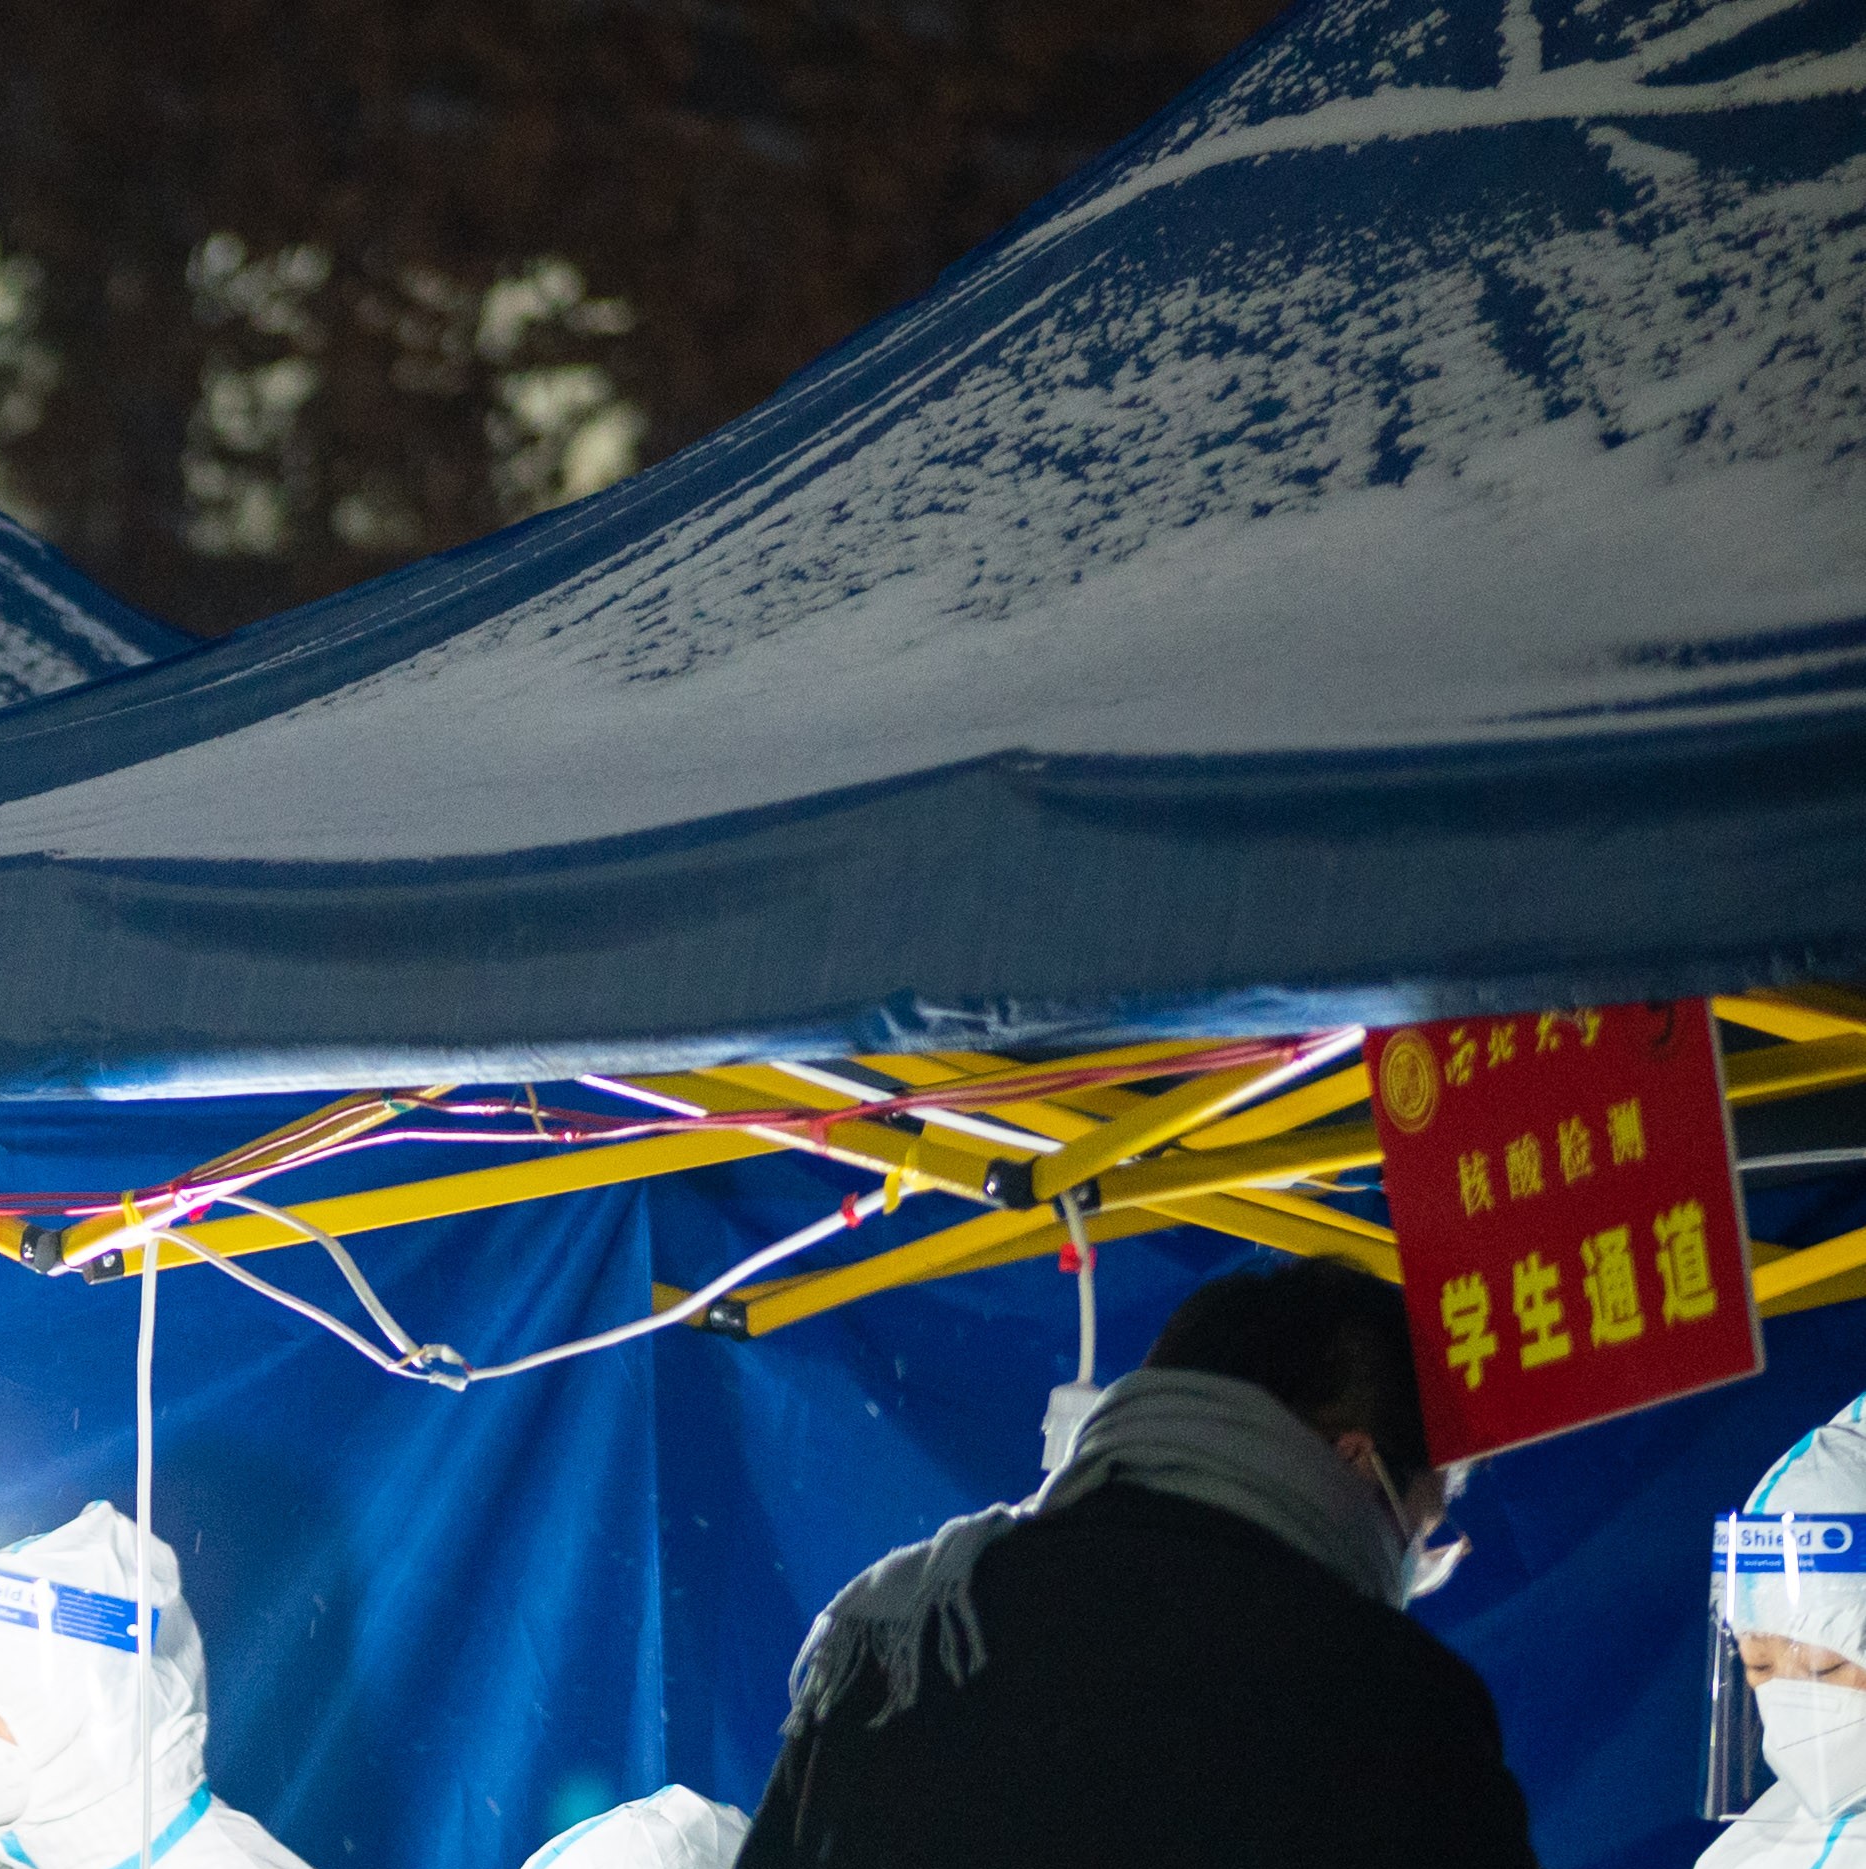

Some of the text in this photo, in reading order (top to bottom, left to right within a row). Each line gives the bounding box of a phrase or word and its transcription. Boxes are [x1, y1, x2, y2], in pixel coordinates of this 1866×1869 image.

[1457, 1098, 1647, 1217] 核酸检测
[1440, 1197, 1718, 1391] 学生通道
[1740, 1528, 1812, 1547] Shied
